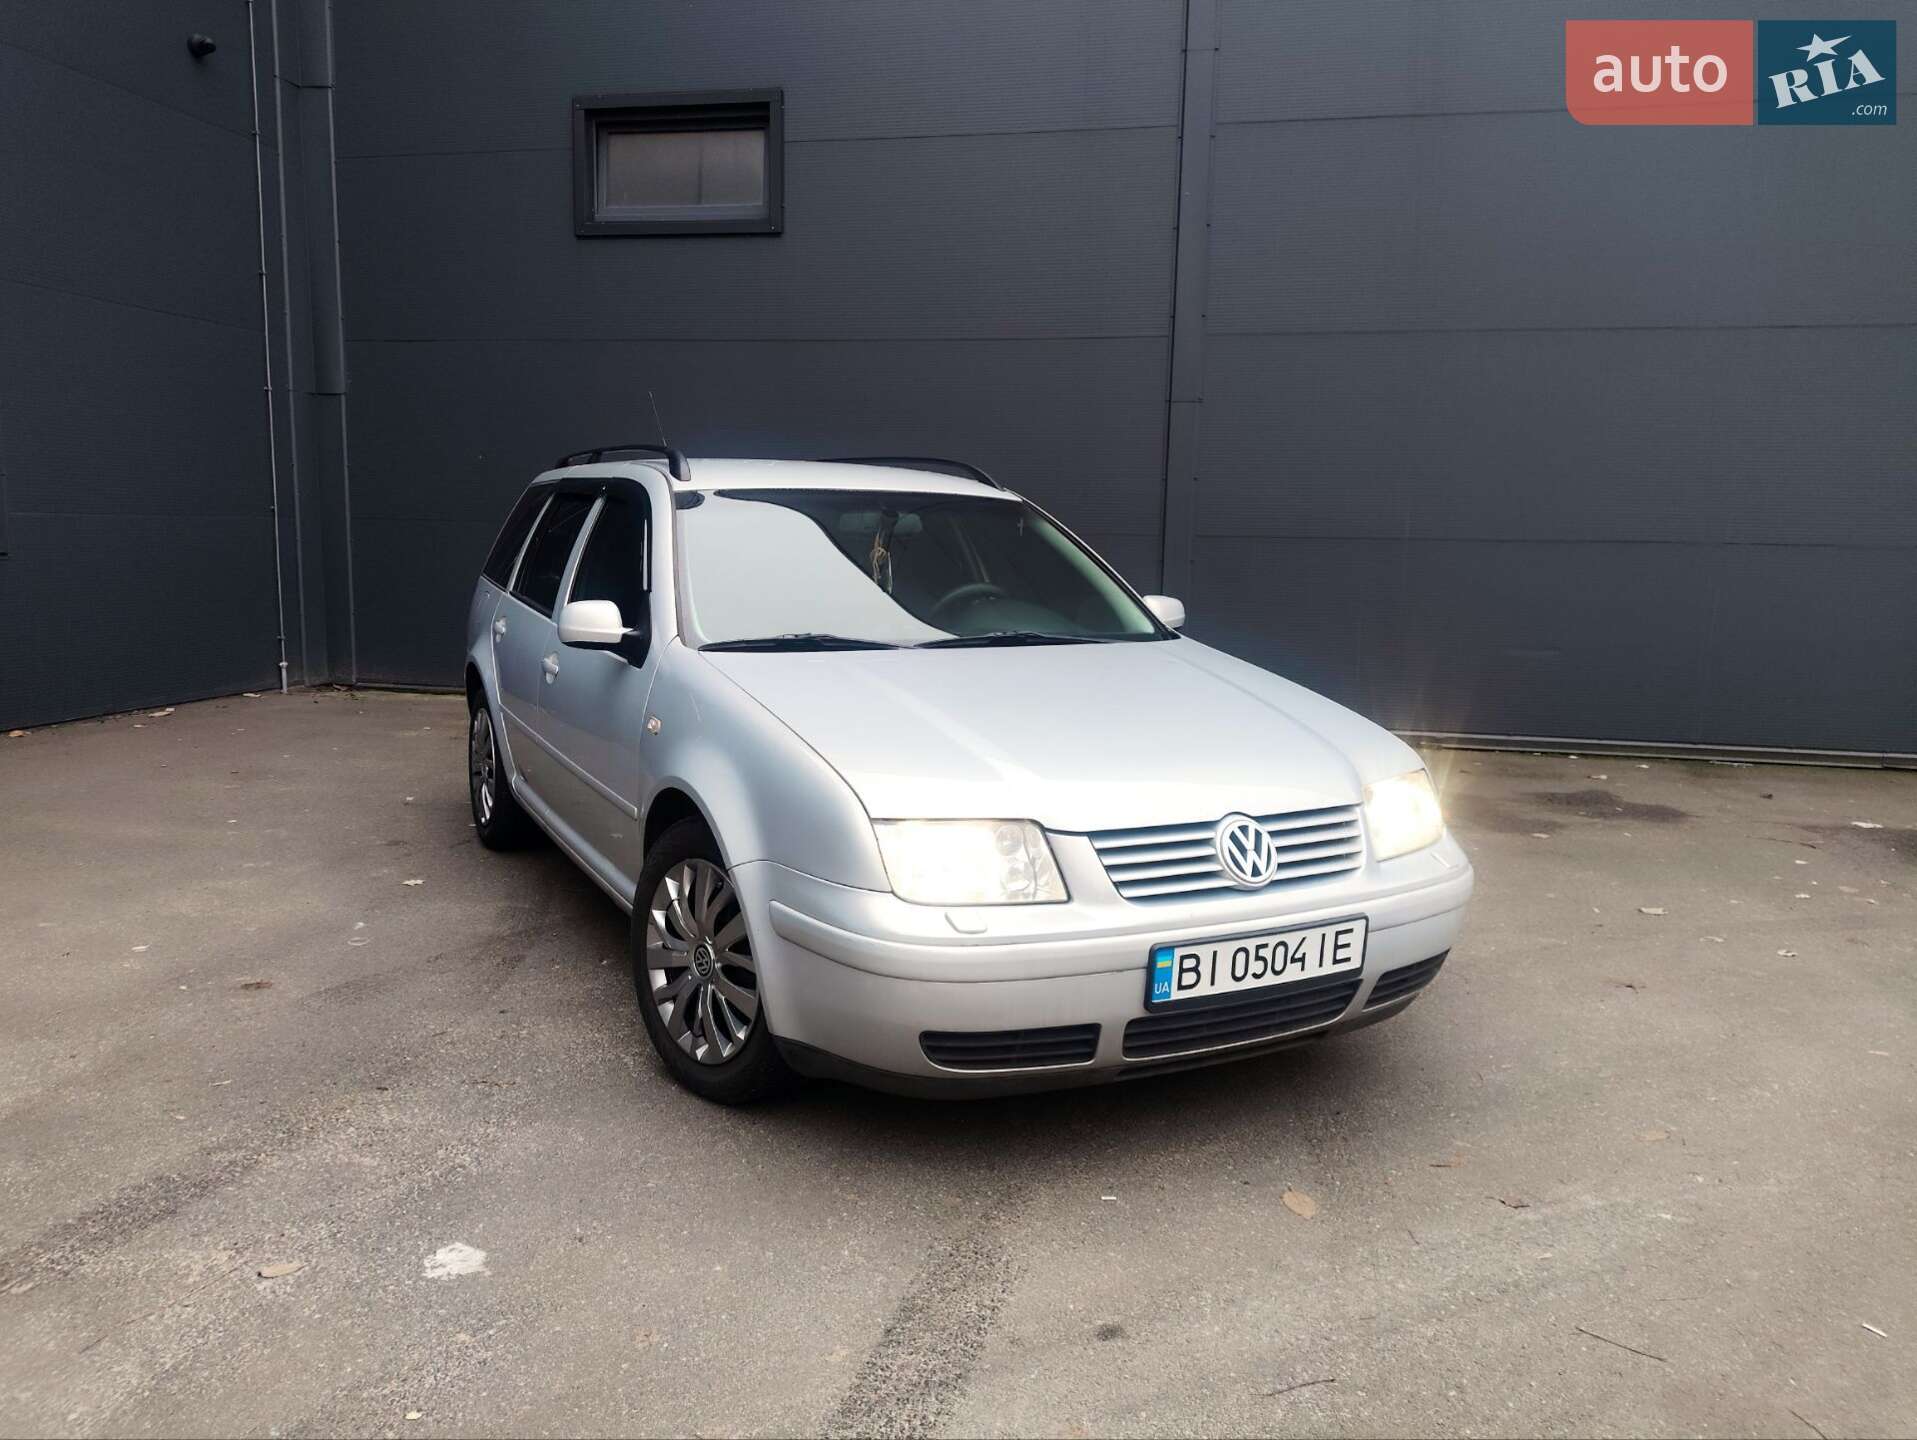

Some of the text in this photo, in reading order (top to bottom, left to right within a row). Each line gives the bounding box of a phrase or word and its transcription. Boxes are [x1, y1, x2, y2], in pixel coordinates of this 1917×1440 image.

[1224, 820, 1273, 881] VW
[1154, 980, 1170, 995] UA
[1176, 928, 1354, 991] BI 0504 IE
